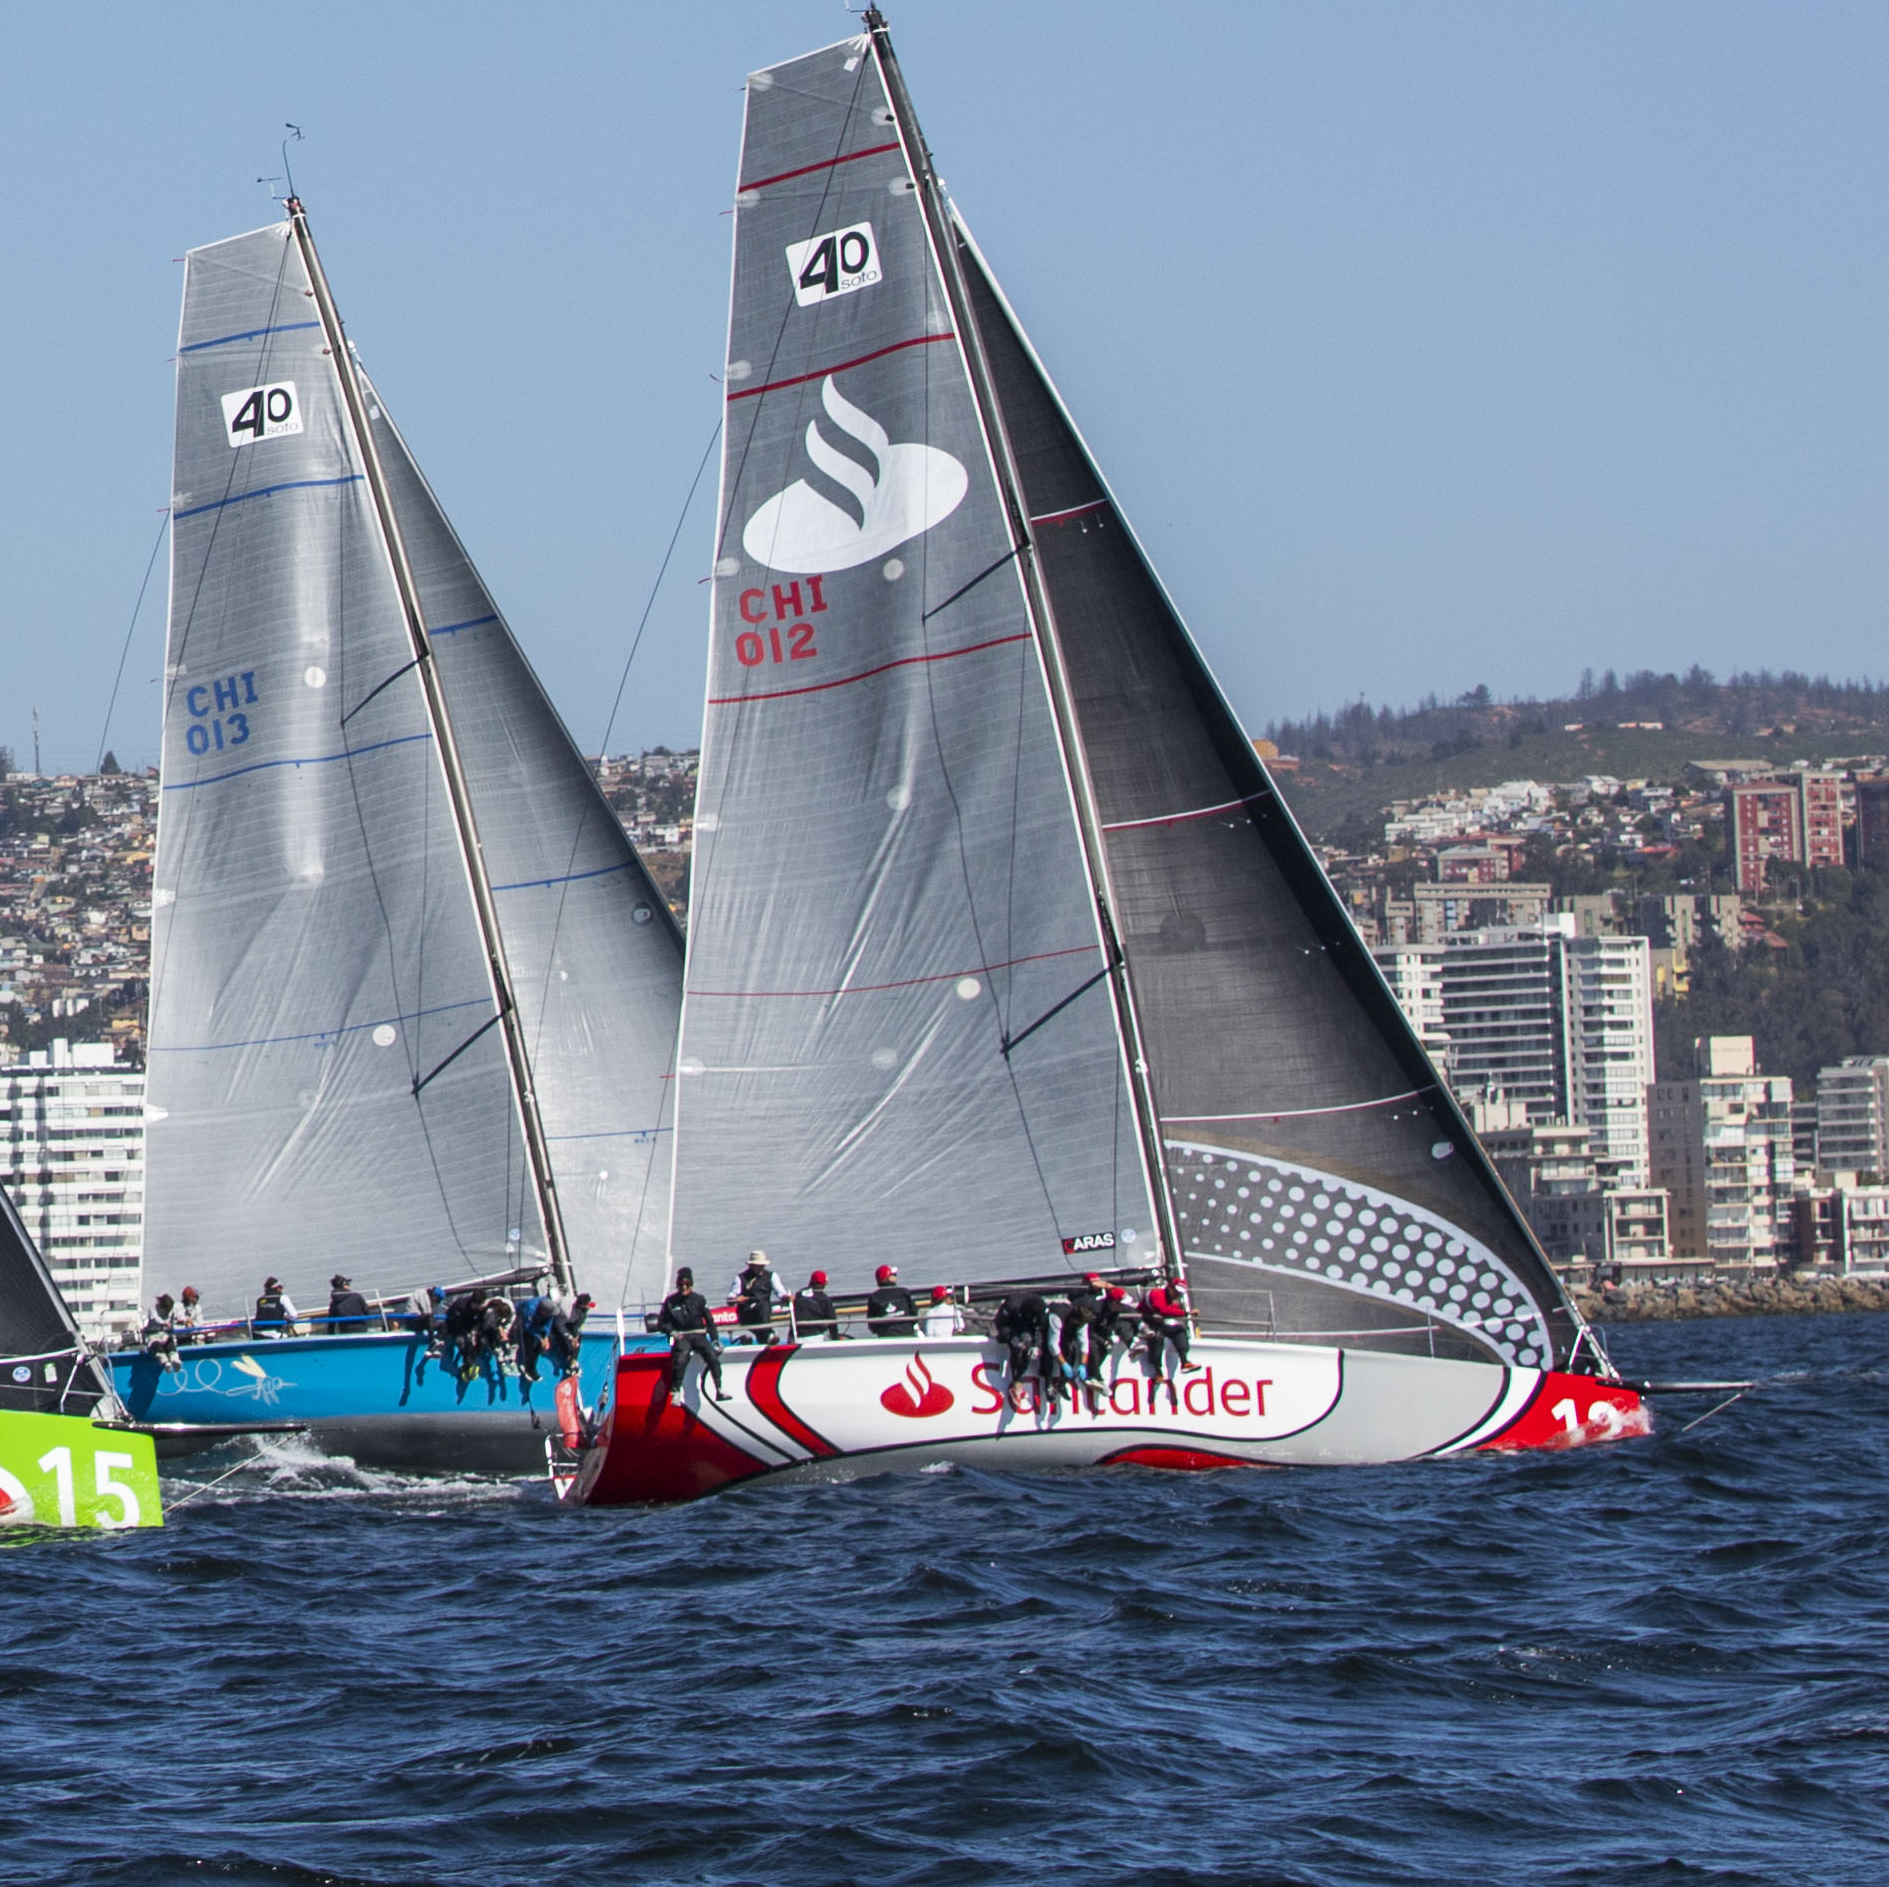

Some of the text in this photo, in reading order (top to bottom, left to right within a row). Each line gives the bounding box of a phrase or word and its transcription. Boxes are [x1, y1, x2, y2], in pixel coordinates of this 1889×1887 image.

[800, 231, 869, 294] 40
[841, 271, 877, 289] soto
[232, 388, 292, 438] 40
[267, 423, 298, 435] soto
[739, 575, 828, 624] CHI
[735, 622, 818, 667] 012
[186, 671, 259, 718] CHI
[186, 713, 250, 755] 013
[37, 1446, 141, 1530] 15
